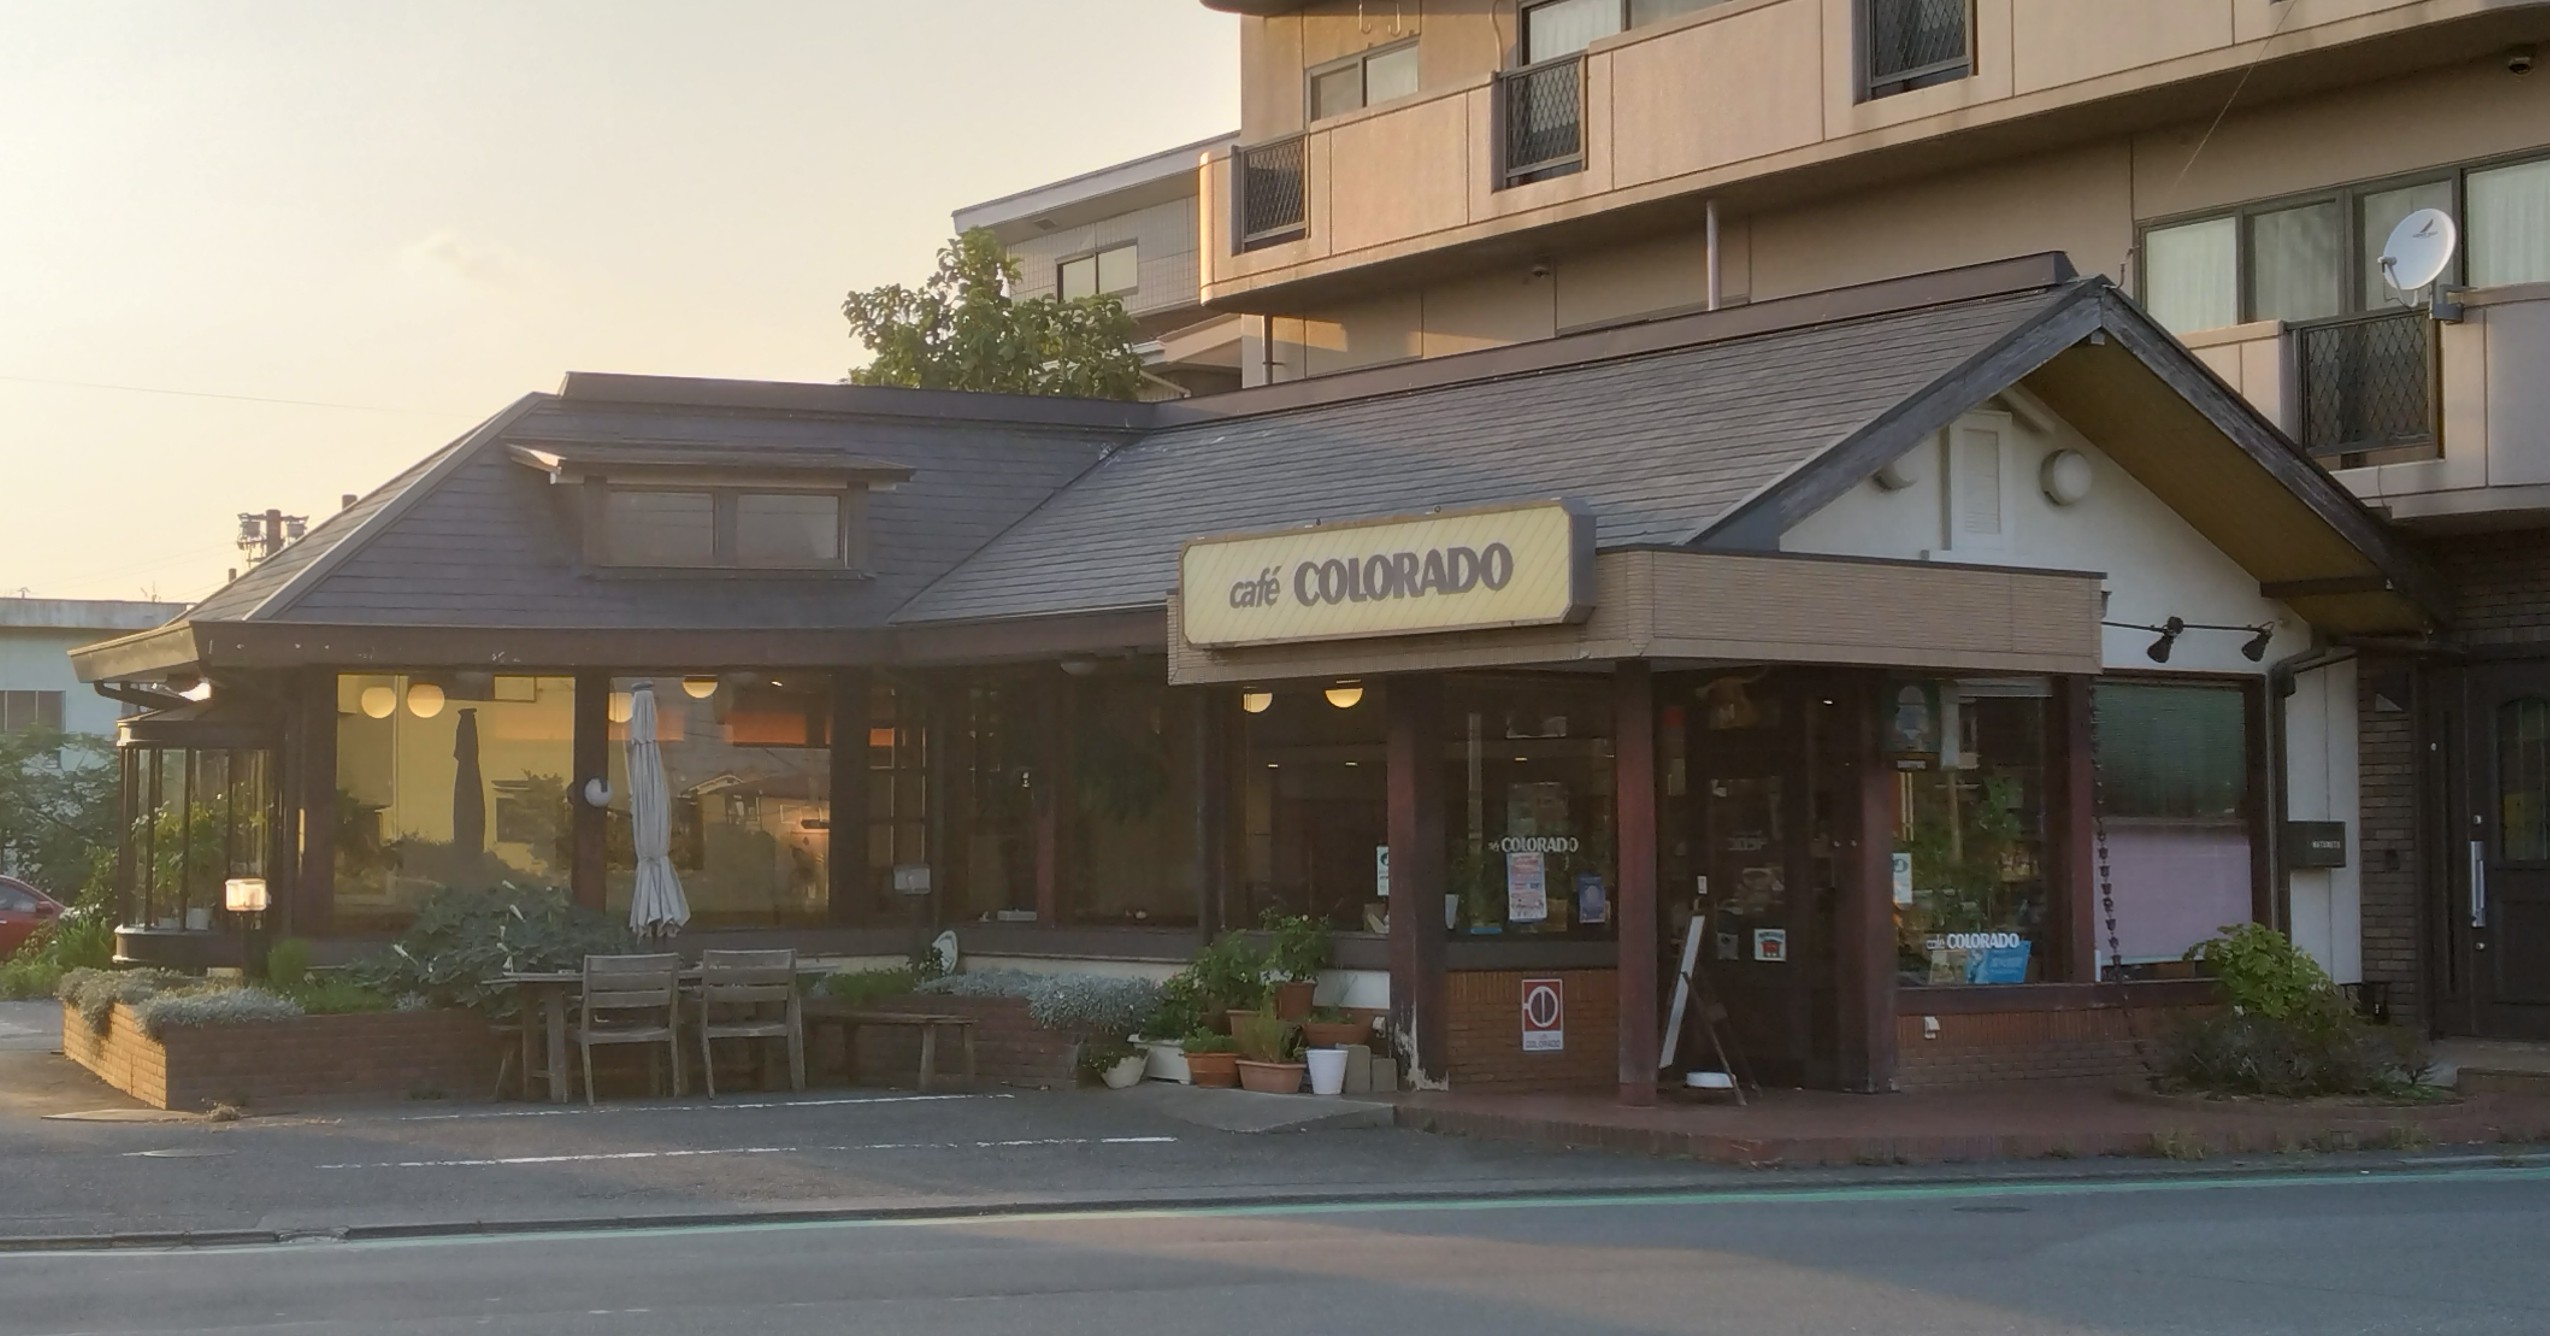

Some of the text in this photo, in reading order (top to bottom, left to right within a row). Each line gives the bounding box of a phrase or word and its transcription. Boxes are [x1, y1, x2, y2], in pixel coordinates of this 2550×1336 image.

[1229, 541, 1514, 608] café COLORADO
[1501, 836, 1579, 853] COLORADO
[1947, 932, 2020, 949] COLORADO
